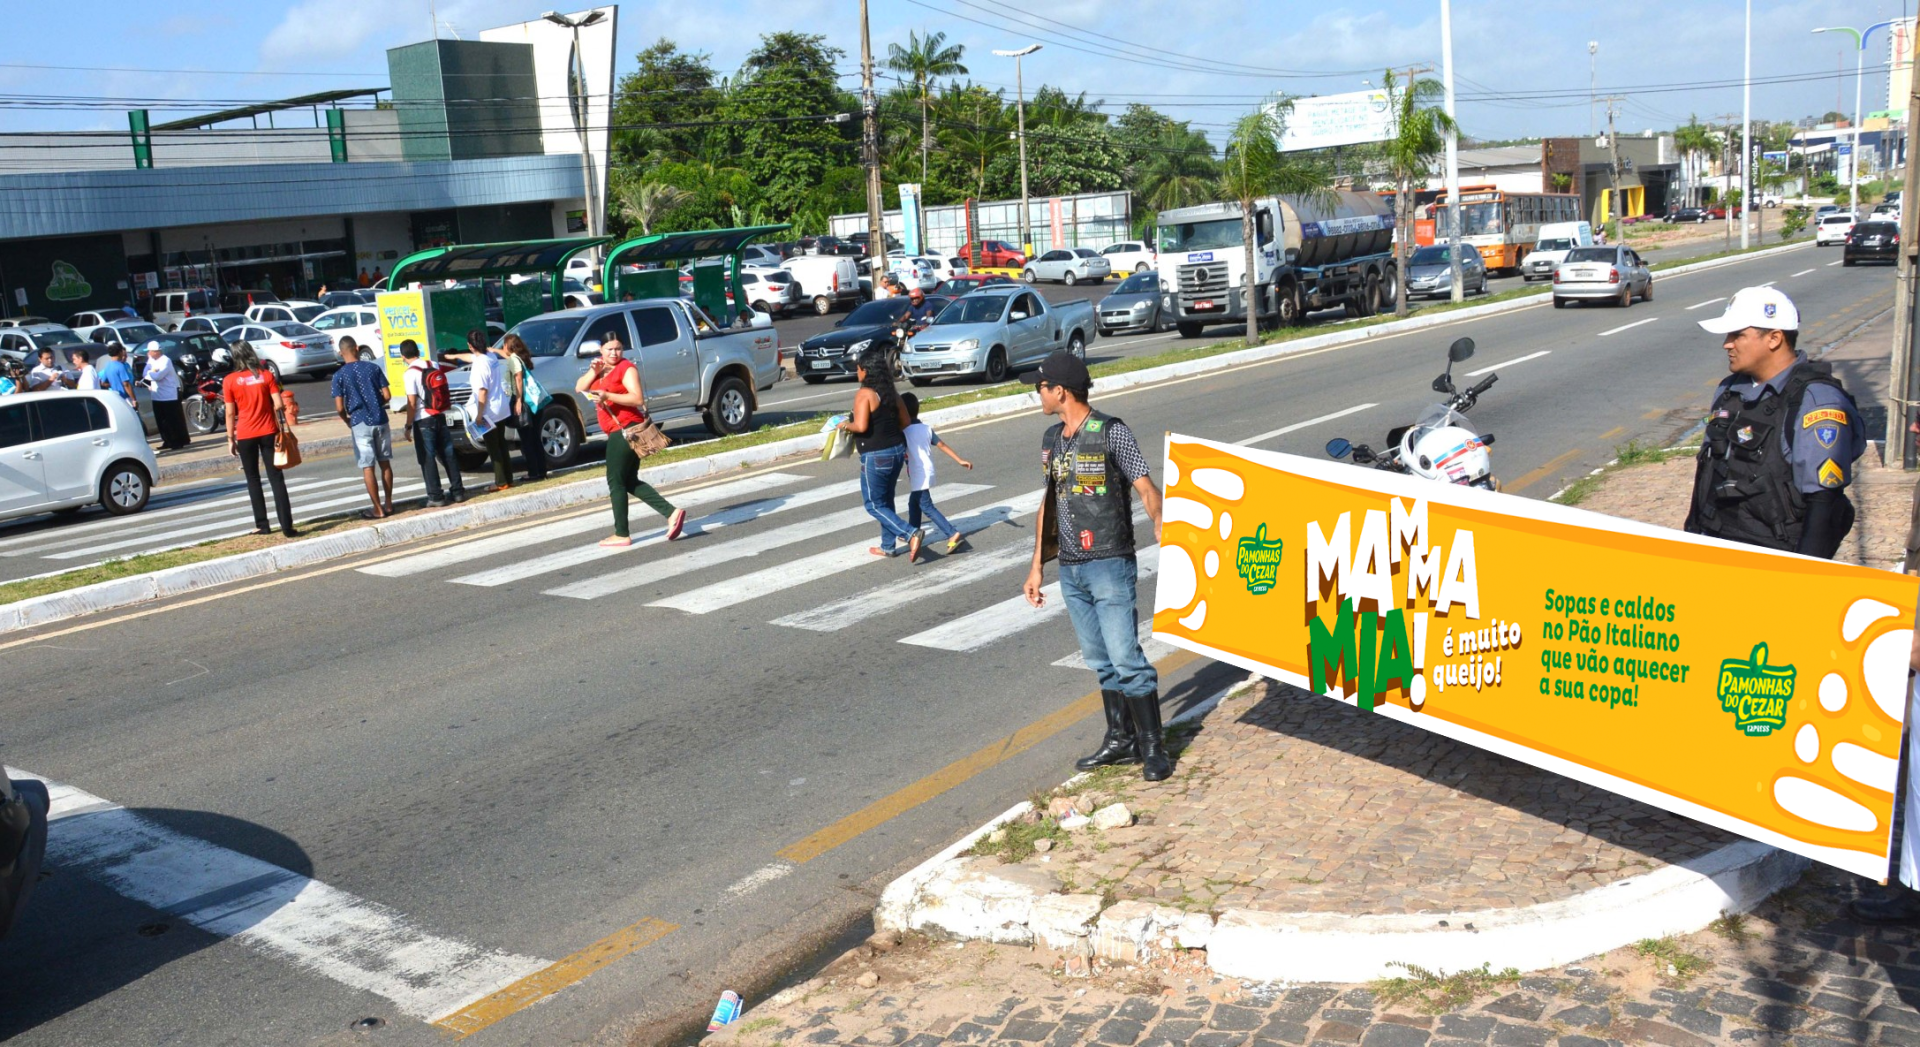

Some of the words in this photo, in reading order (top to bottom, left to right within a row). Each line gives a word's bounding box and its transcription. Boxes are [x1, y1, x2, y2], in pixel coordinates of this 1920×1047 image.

[1238, 546, 1280, 566] PAMONHAS
[1241, 563, 1250, 574] DO
[1249, 563, 1276, 583] CEZAR
[1545, 588, 1596, 618] Sopas
[1600, 597, 1610, 616] e
[1614, 595, 1675, 622] caldos
[1443, 627, 1454, 657] é
[1459, 618, 1521, 655] muito
[1543, 621, 1563, 640] no
[1568, 619, 1601, 644] Pão
[1606, 622, 1680, 652] Italiano
[1308, 597, 1427, 712] MIA!
[1541, 649, 1572, 672] que
[1576, 648, 1609, 673] vão
[1613, 656, 1690, 683] aquecer
[1433, 655, 1501, 692] queijo!
[1720, 671, 1792, 696] PAMONHAS
[1539, 677, 1550, 695] a
[1554, 679, 1584, 699] sua
[1589, 684, 1639, 709] copa!
[1725, 694, 1739, 708] DO
[1738, 694, 1784, 720] CEZAR
